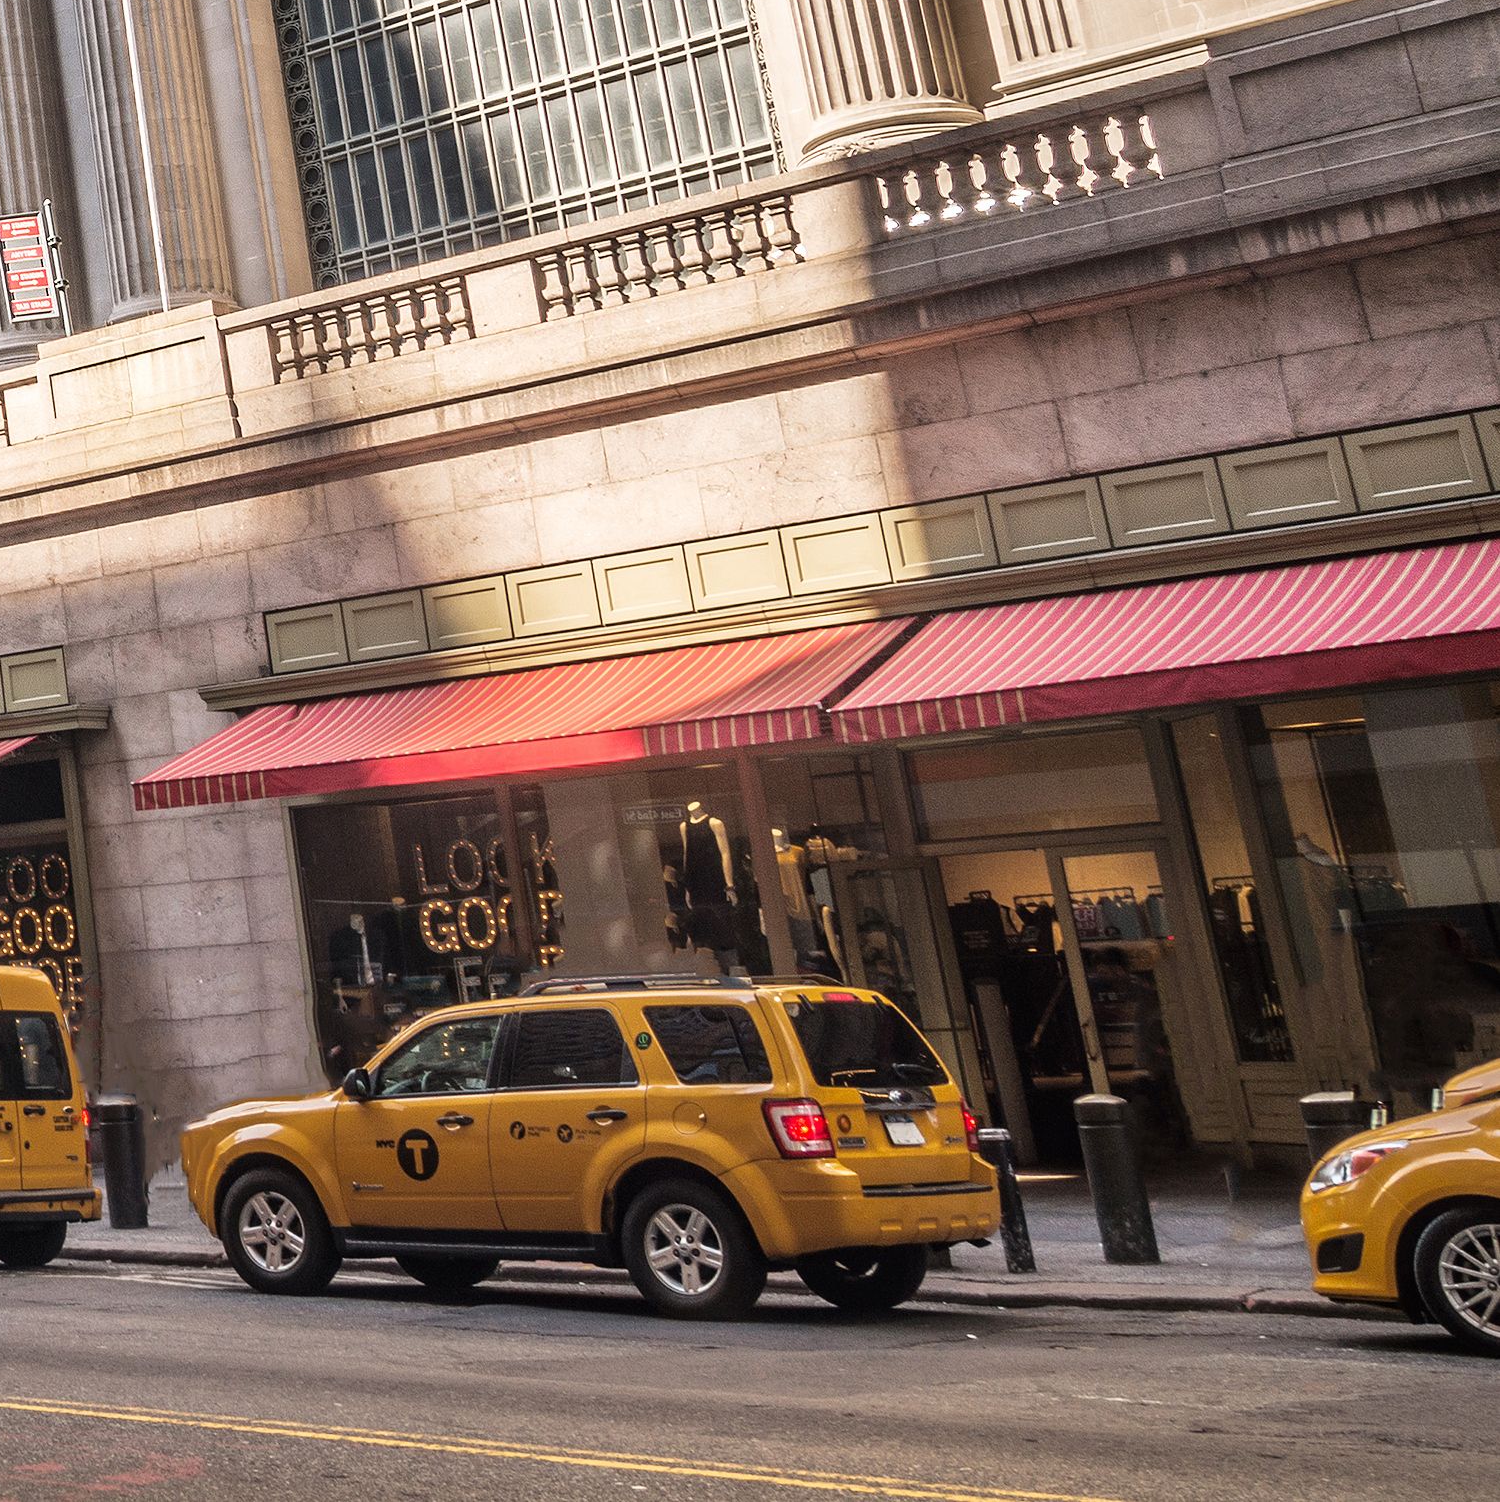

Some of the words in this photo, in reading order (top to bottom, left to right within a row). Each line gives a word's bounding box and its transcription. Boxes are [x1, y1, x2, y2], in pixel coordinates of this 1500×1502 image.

[11, 250, 38, 258] ANYTIME
[376, 1139, 395, 1149] NYC
[405, 1139, 428, 1175] T
